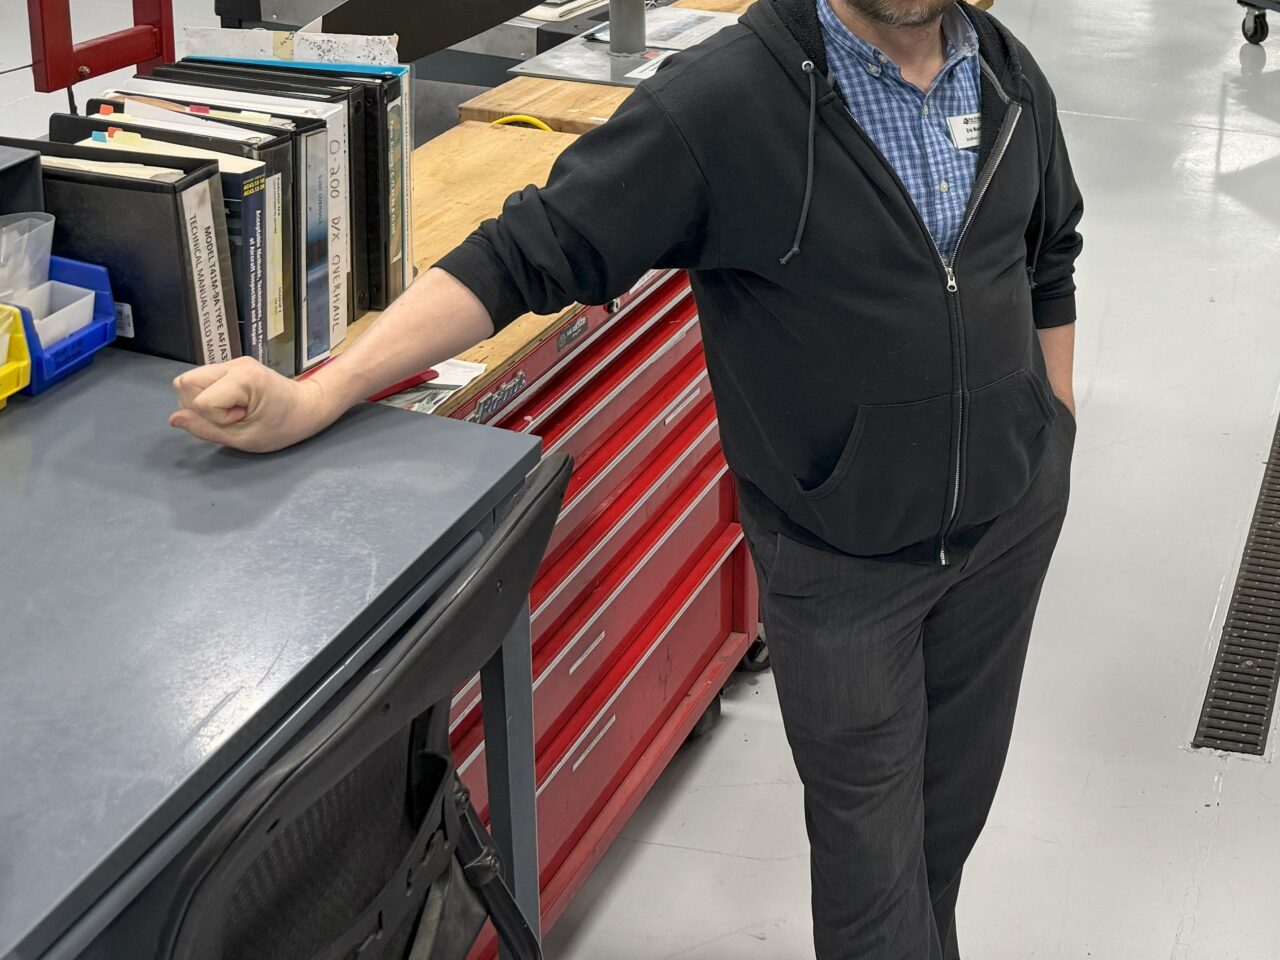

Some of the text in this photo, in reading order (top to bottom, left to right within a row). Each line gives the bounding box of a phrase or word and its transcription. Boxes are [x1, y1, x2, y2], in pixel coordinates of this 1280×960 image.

[203, 225, 215, 263] MODEL
[249, 237, 255, 245] of
[189, 214, 216, 365] TECHNICAL MANUAL FIELD MAIN
[207, 263, 220, 307] T41M-9A
[331, 254, 341, 333] OVERHAUL
[214, 307, 224, 330] TYPE
